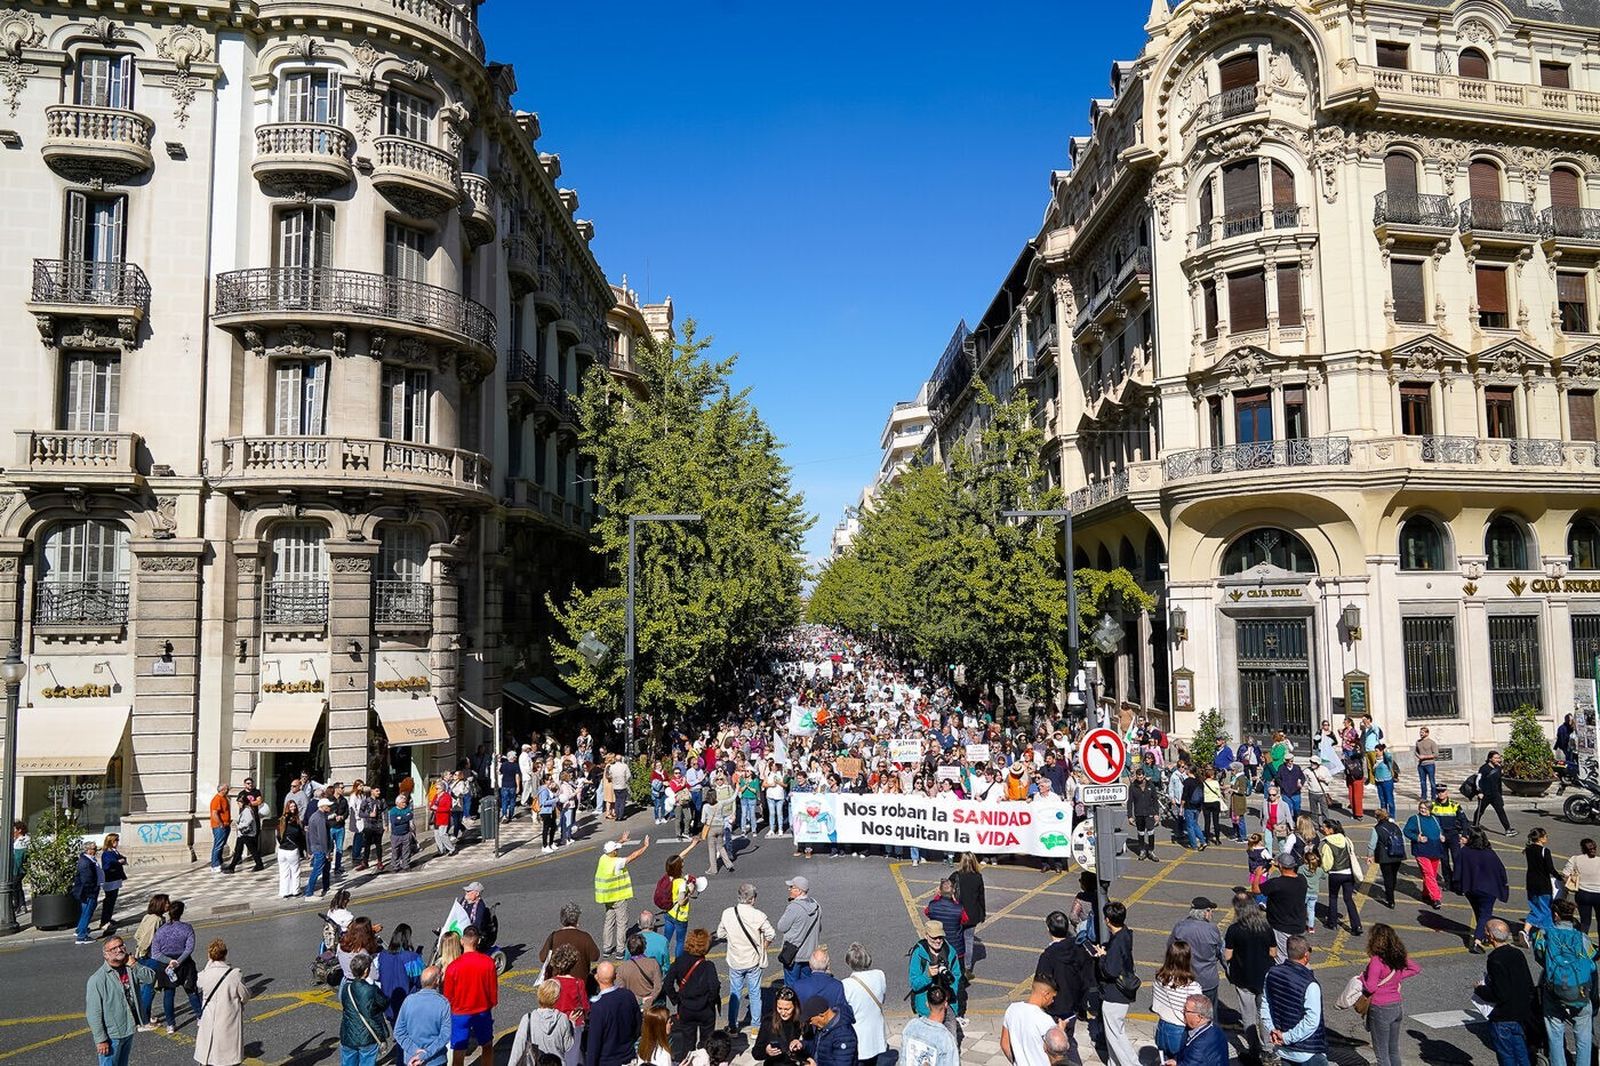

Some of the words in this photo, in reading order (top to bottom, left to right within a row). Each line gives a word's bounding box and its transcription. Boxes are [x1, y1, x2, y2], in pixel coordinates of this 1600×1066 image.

[1247, 589, 1268, 598] CAJA
[1271, 588, 1302, 597] RURAL
[1530, 578, 1561, 593] CAJA
[1562, 579, 1600, 593] RURA
[843, 802, 877, 816] Nos
[881, 803, 927, 820] roban
[932, 807, 948, 822] la
[952, 809, 1032, 826] SANIDAD
[861, 821, 893, 836] Nos
[895, 824, 949, 842] quitan
[954, 828, 970, 843] la
[976, 831, 1020, 846] VIDA
